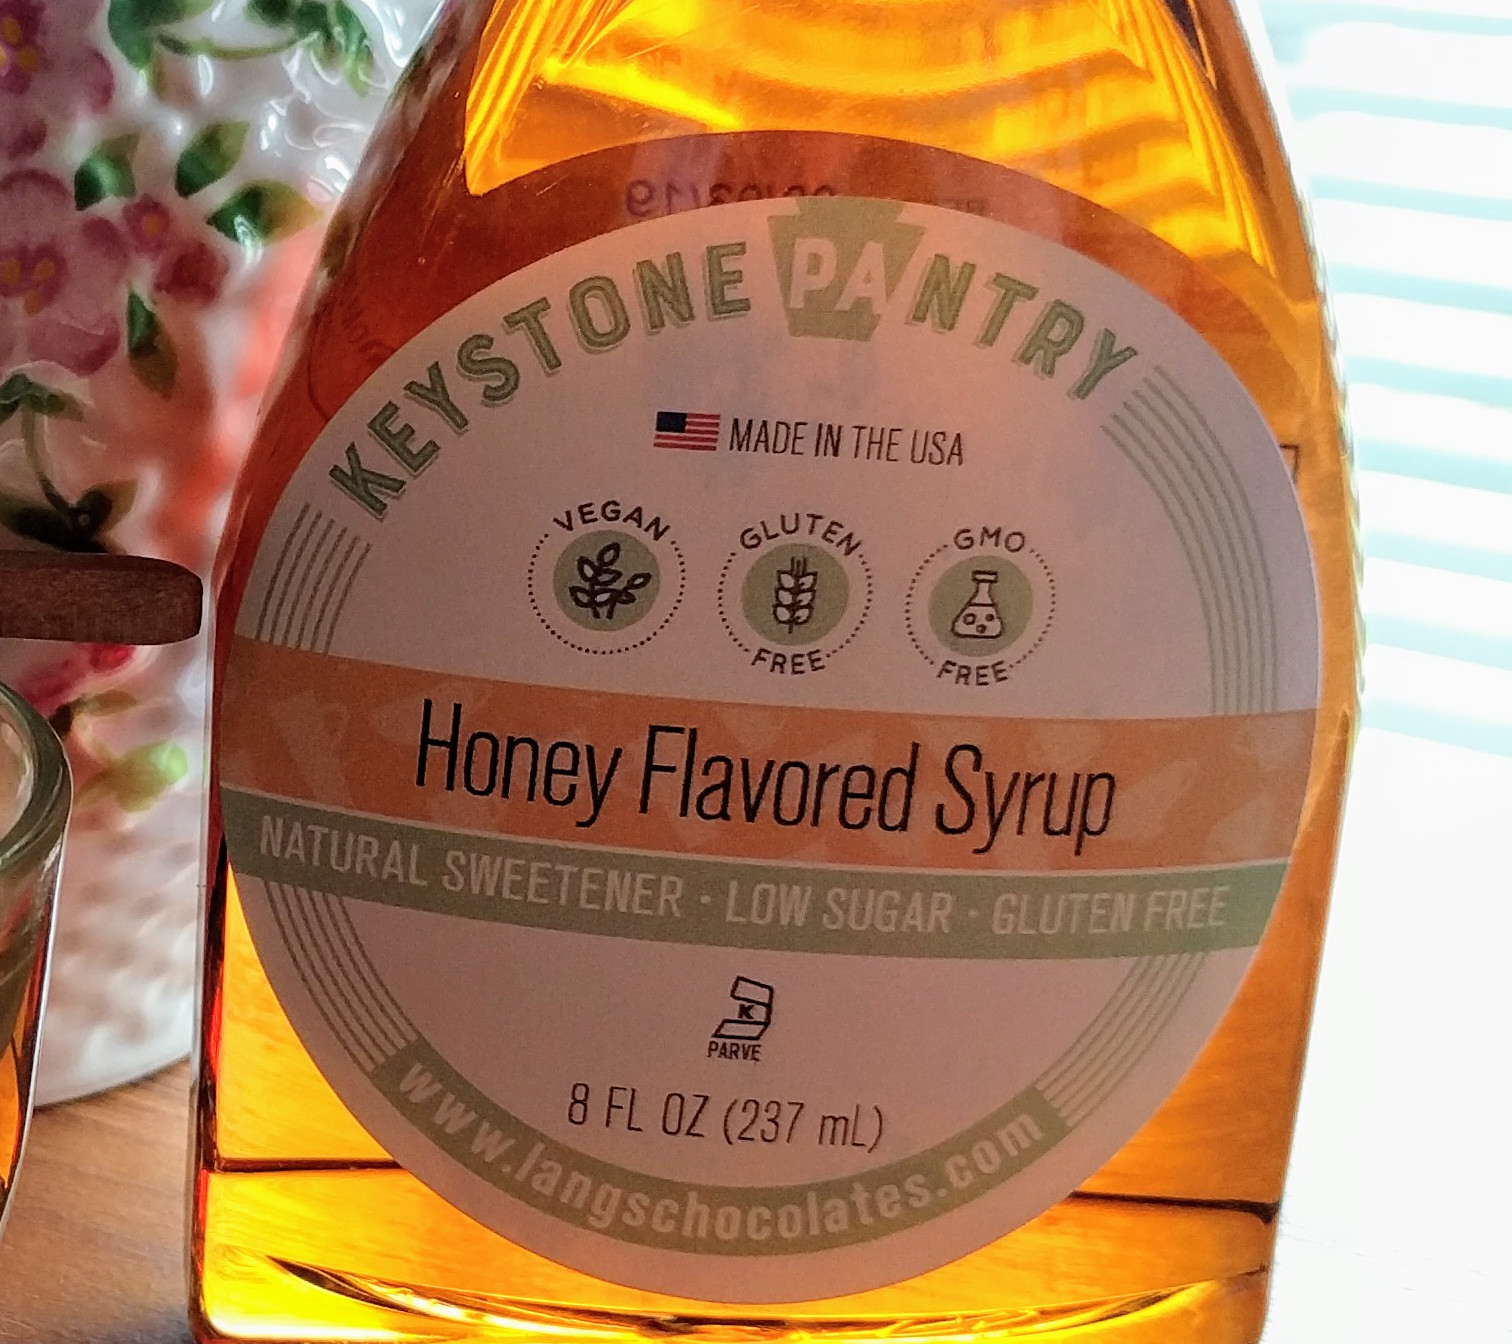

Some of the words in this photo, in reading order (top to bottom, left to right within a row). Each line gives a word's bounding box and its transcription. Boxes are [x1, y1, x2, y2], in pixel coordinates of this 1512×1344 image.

[327, 241, 752, 520] KEYSTONE
[788, 234, 1138, 401] PANTRY
[728, 416, 807, 456] MADE
[814, 421, 843, 458] IN
[852, 424, 903, 462] THE
[909, 429, 965, 467] USA
[552, 499, 671, 543] VEGAN
[738, 512, 862, 558] GLUTEN
[953, 525, 1027, 553] GMO
[750, 647, 827, 676] FREE
[936, 659, 1010, 687] FREE
[415, 697, 623, 829] Honey
[637, 723, 921, 834] Flavored
[934, 742, 1117, 856] Syrup
[259, 814, 428, 888] NATURAL
[441, 849, 683, 919] SWEETENER
[725, 880, 813, 927] LOW
[822, 887, 953, 934] SUGAR
[991, 892, 1136, 935] GLUTEN
[1143, 884, 1232, 933] FREE
[707, 1040, 762, 1062] PARVE
[567, 1082, 589, 1126] 8
[605, 1085, 643, 1133] FL
[661, 1092, 710, 1138] OZ
[723, 1098, 805, 1146] (237
[817, 1103, 884, 1154] mL)
[398, 1061, 1044, 1242] www.langschocolates.com
